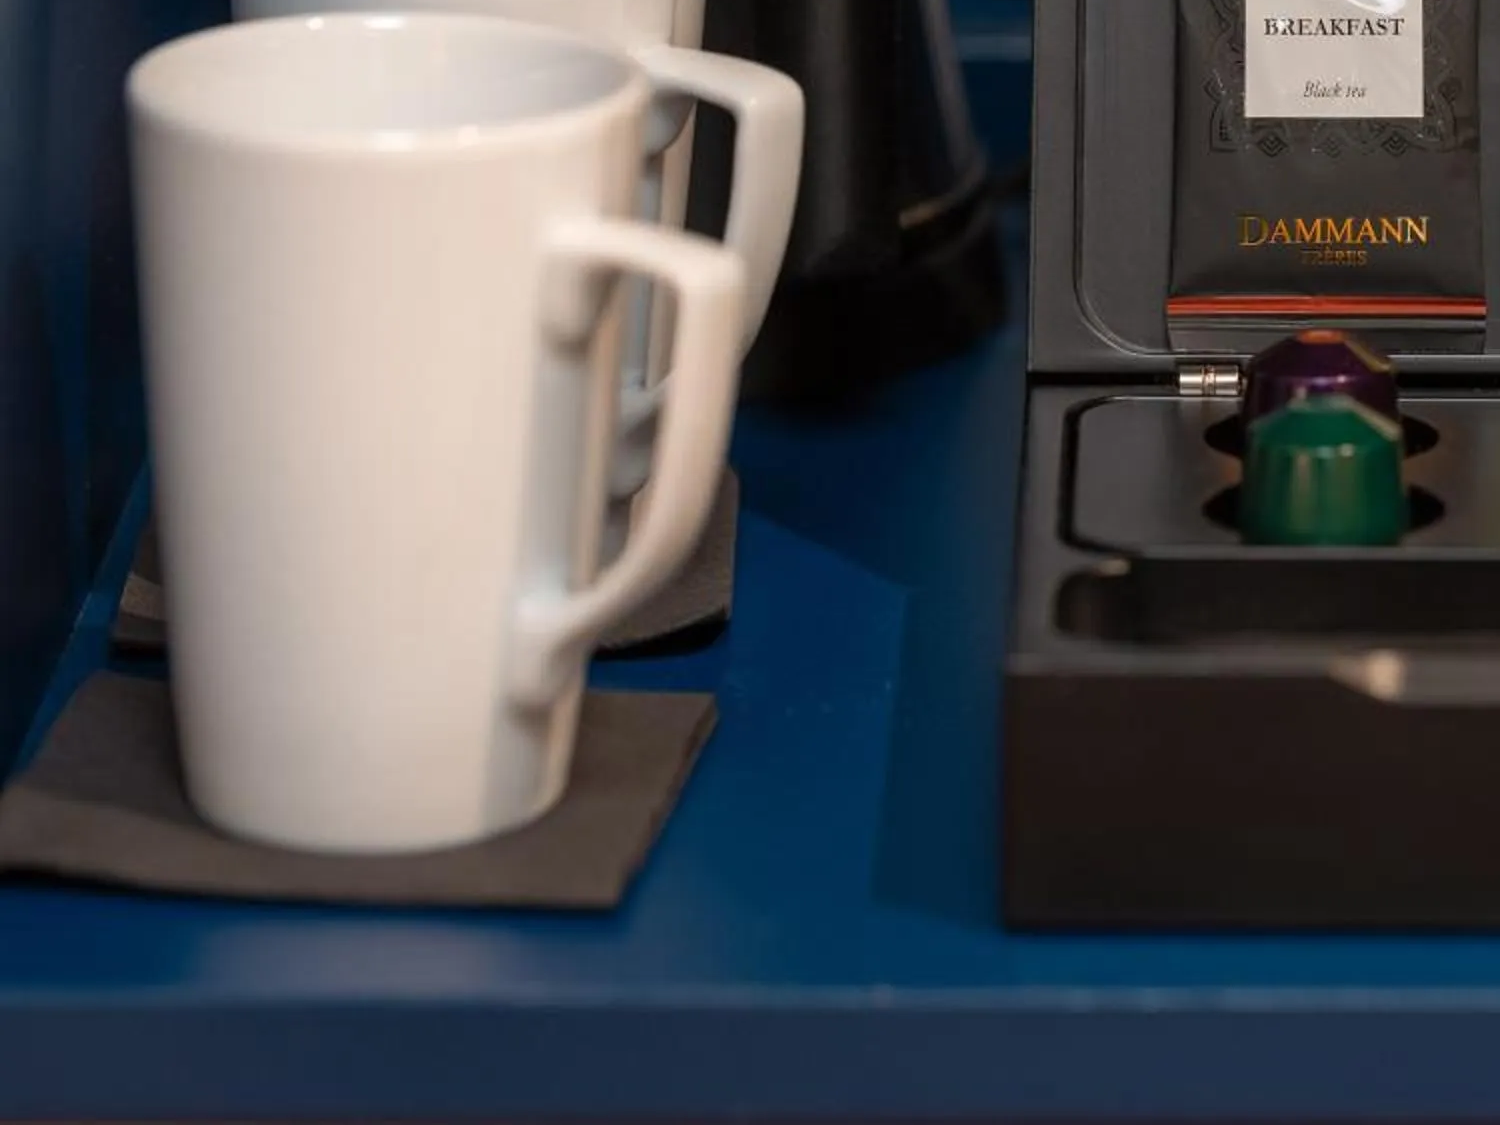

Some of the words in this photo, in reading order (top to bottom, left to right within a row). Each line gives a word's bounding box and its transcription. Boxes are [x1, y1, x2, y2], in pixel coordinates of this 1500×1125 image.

[1263, 18, 1405, 36] BREAKFAST
[1303, 80, 1343, 98] Black
[1345, 85, 1367, 98] tea
[1239, 216, 1430, 246] DAMMANN
